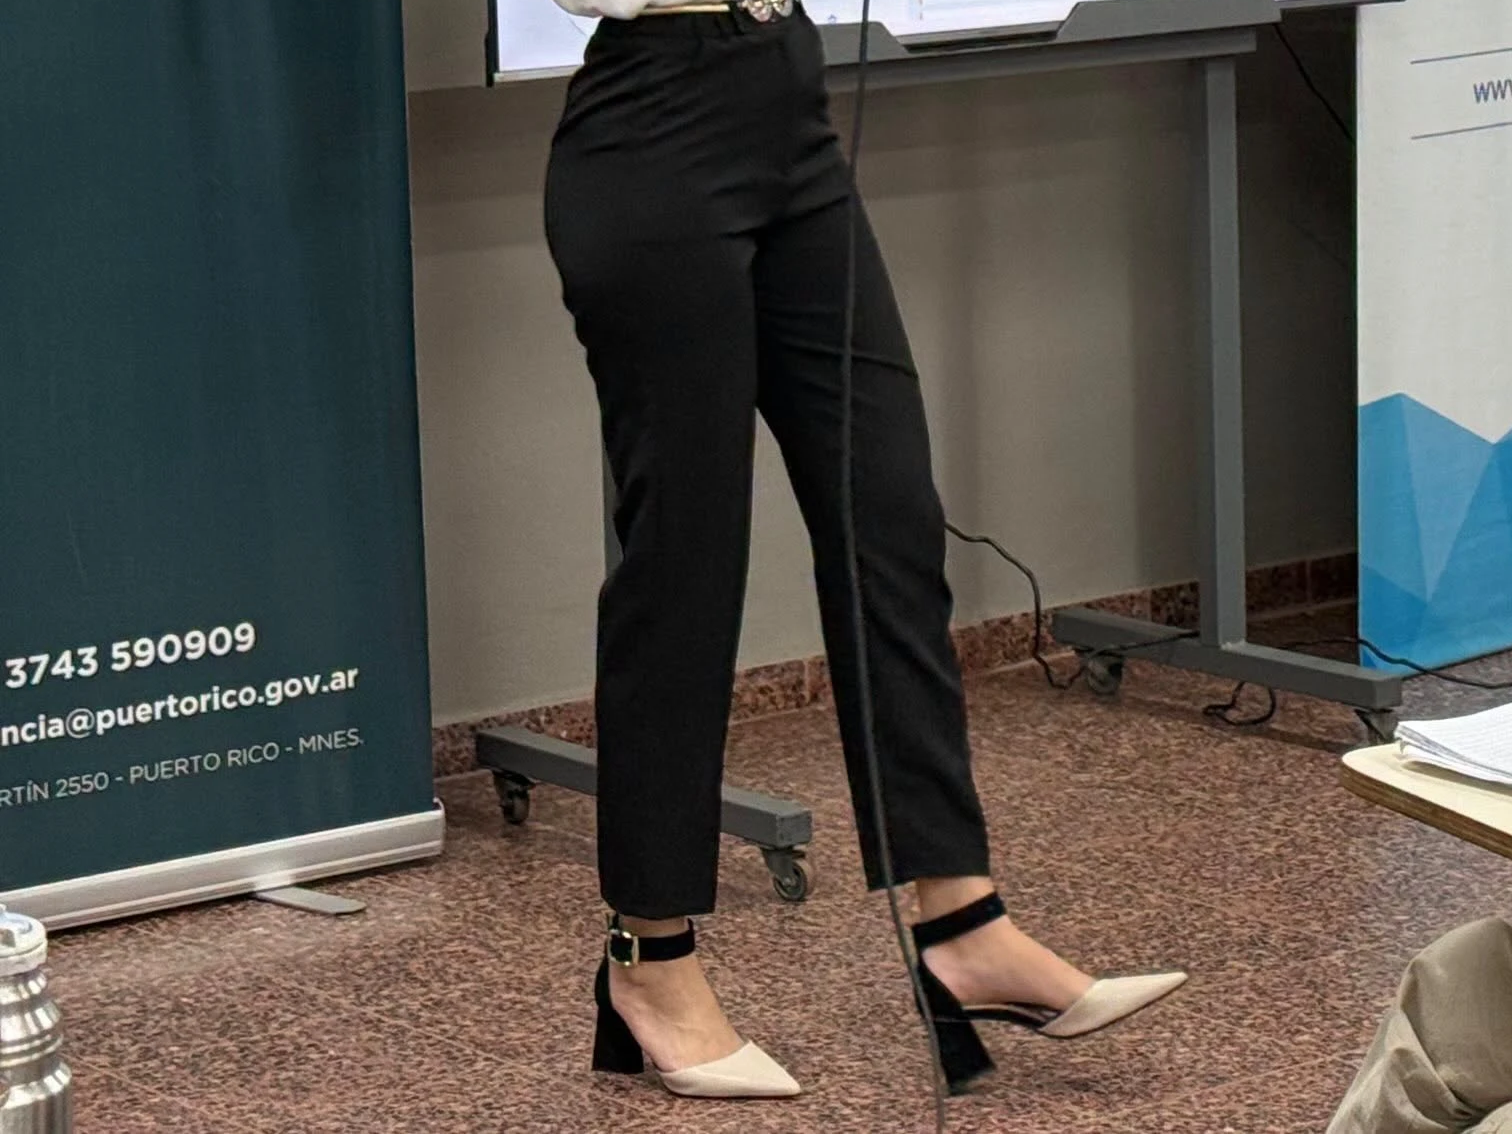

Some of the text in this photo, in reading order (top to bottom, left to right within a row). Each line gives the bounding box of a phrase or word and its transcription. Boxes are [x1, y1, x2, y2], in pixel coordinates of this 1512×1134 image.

[5, 621, 256, 689] 3743 590909
[0, 667, 358, 747] ncia@puertorico.gov.ar
[55, 772, 109, 798] 2550
[130, 753, 221, 785] PUERTO
[227, 742, 280, 768] RICO
[299, 728, 364, 755] MNES.
